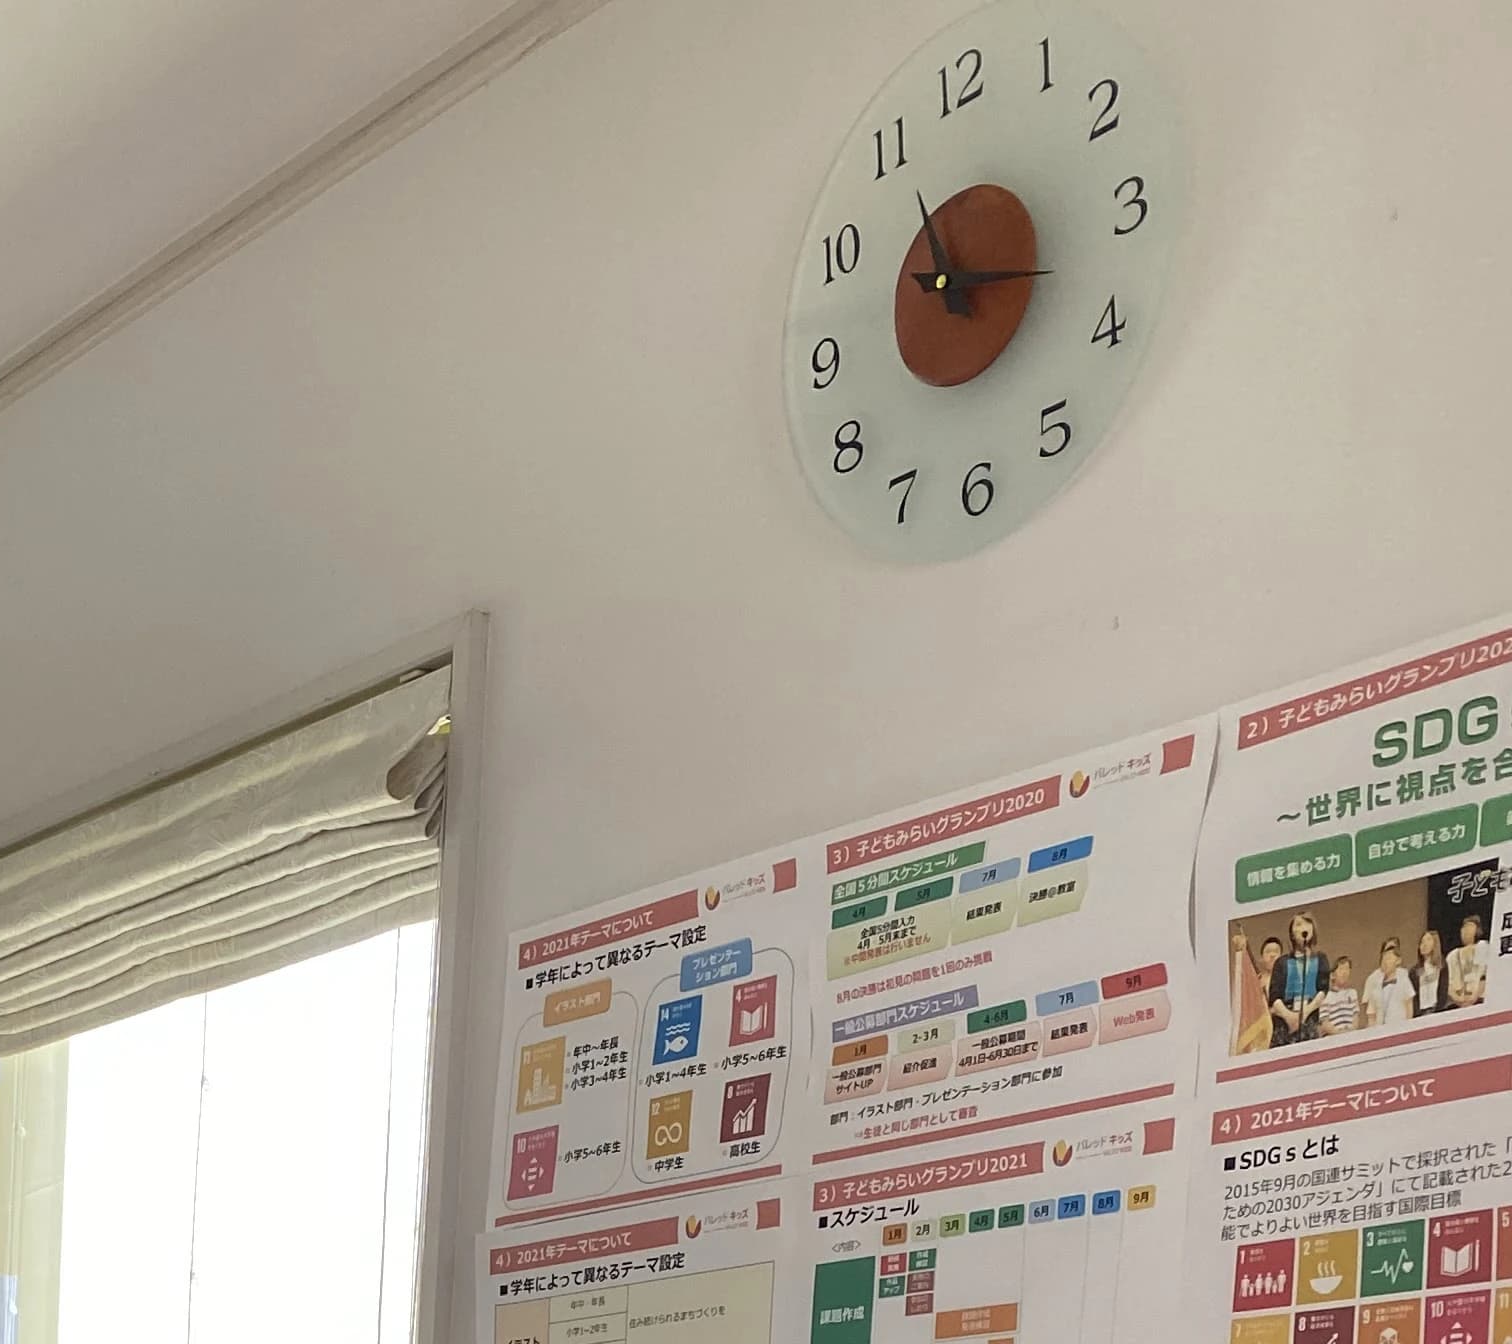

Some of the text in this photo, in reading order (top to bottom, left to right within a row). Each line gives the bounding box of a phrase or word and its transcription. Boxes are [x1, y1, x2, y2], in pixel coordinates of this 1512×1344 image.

[1039, 38, 1055, 92] 1
[937, 49, 984, 118] 12
[1088, 79, 1119, 142] 2
[873, 117, 908, 180] 11
[1113, 176, 1147, 235] 3
[823, 224, 861, 285] 10
[1091, 295, 1126, 348] 4
[812, 338, 840, 389] 9
[1040, 399, 1071, 457] 5
[833, 420, 863, 473] 8
[889, 469, 918, 524] 7
[962, 462, 994, 516] 6
[1372, 696, 1512, 768] SDG
[1368, 824, 1465, 859] 自分で考える力
[1247, 853, 1340, 887] 情報を集める力
[1058, 992, 1073, 1005] 7月
[654, 1157, 684, 1172] 中学生
[1097, 1196, 1114, 1209] 8月
[1133, 1191, 1149, 1204] 9月
[829, 1199, 919, 1229] スケジュール
[1034, 1206, 1049, 1218] 6月
[1064, 1201, 1079, 1213] 7月
[974, 1215, 989, 1227] 4月
[1004, 1211, 1019, 1222] 5月
[1502, 1213, 1510, 1227] 5
[916, 1224, 930, 1237] 2月
[944, 1220, 960, 1231] 3月
[1433, 1222, 1441, 1237] 4
[888, 1228, 902, 1241] 1月
[1367, 1232, 1374, 1247] 3
[1363, 1310, 1370, 1324] 9
[1431, 1301, 1443, 1317] 10
[1299, 1317, 1306, 1331] 8
